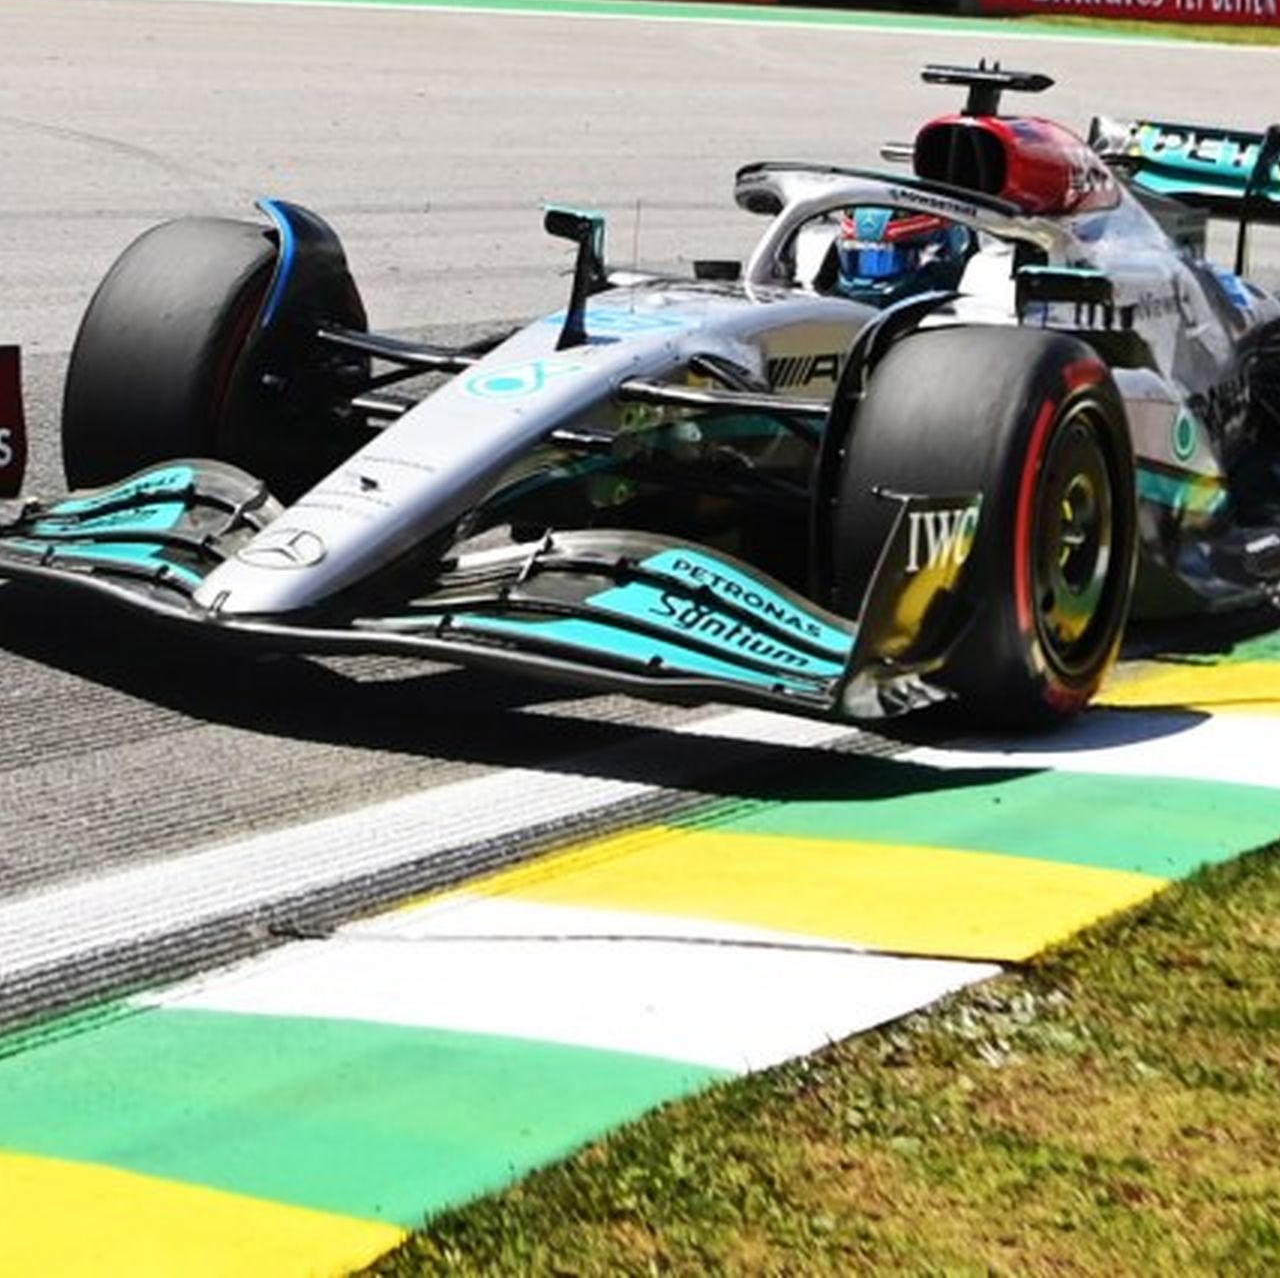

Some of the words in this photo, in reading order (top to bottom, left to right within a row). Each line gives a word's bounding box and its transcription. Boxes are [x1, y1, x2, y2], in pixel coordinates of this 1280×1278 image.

[905, 506, 979, 572] IWC
[648, 591, 809, 668] Syntium
[672, 558, 821, 639] PETRONAS
